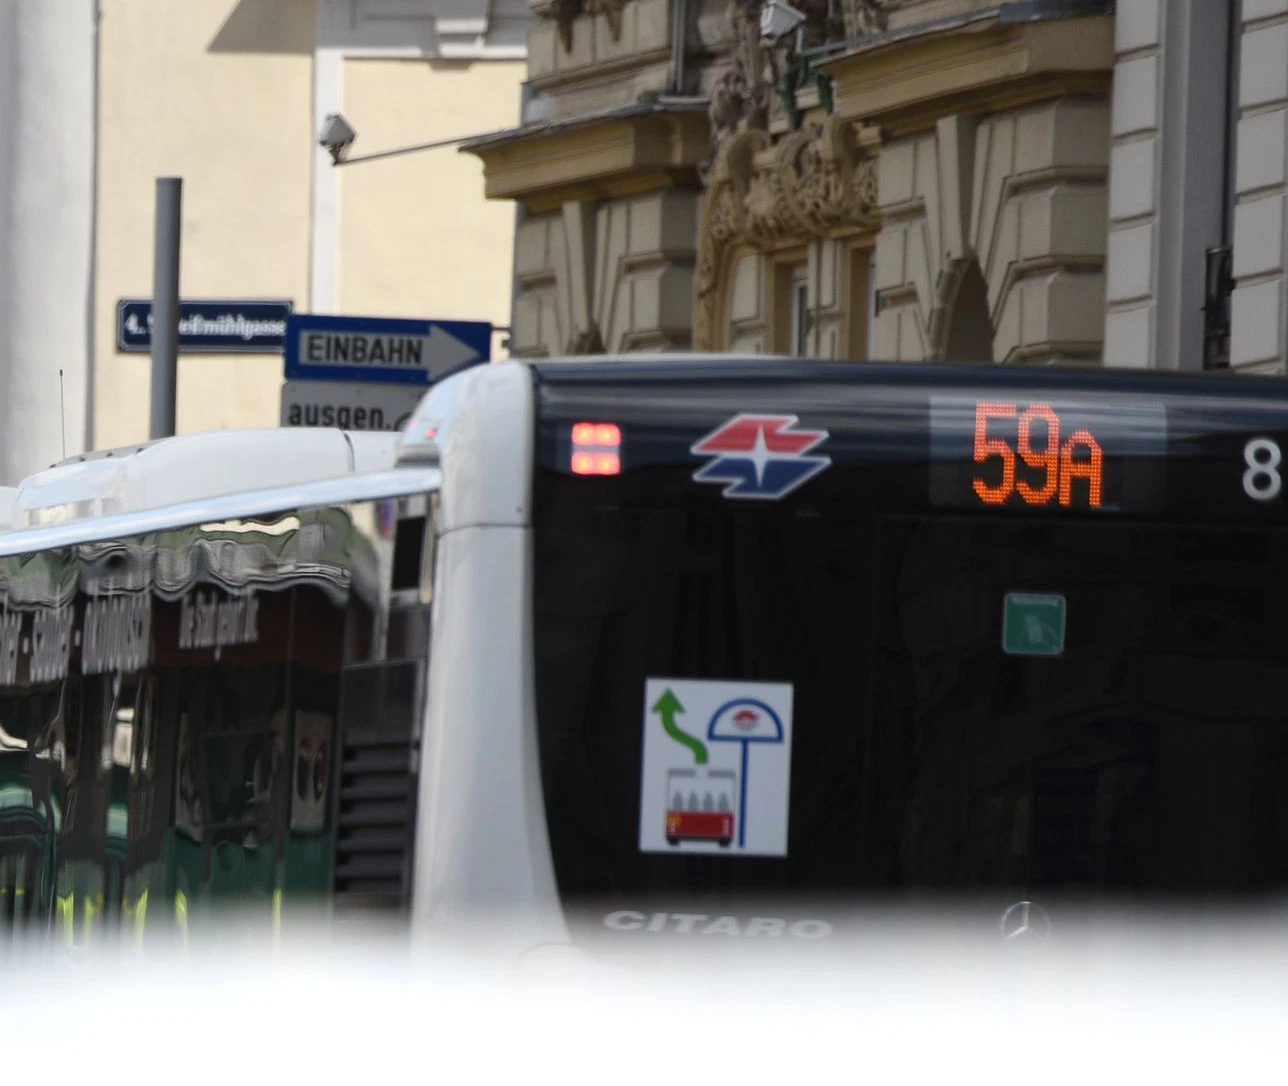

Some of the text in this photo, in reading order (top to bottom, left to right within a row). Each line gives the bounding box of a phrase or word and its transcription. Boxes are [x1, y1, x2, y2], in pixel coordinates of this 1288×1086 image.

[305, 334, 423, 366] EINBAHN
[288, 402, 392, 431] ausgen.
[972, 400, 1104, 508] 59A
[602, 889, 834, 940] CITARO
